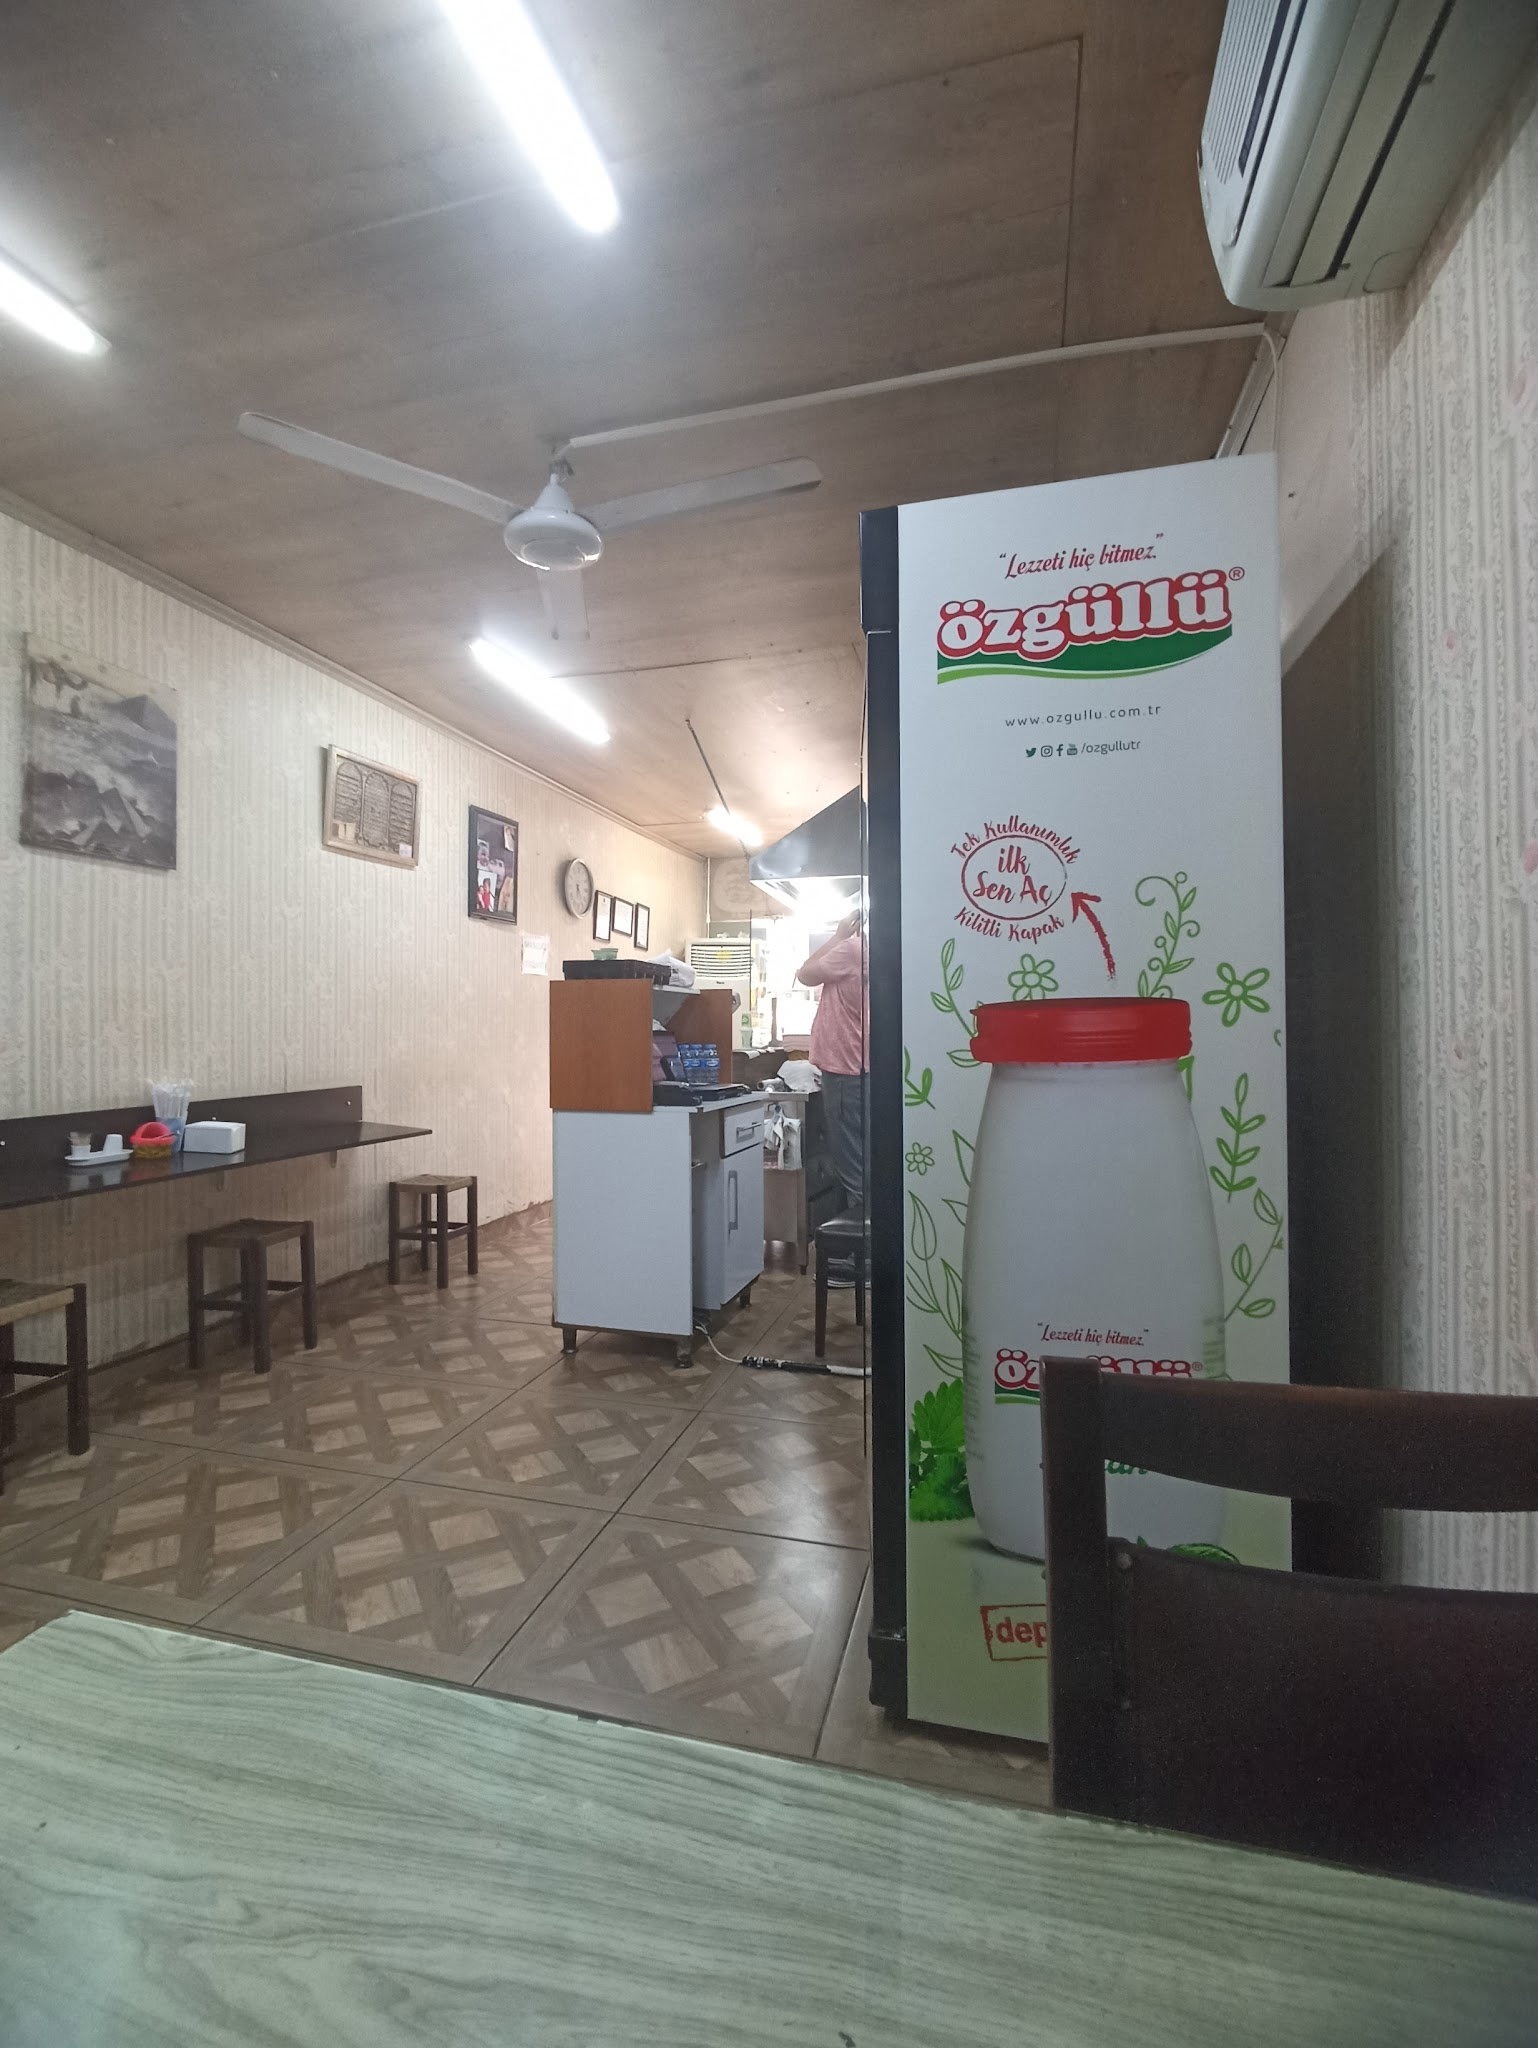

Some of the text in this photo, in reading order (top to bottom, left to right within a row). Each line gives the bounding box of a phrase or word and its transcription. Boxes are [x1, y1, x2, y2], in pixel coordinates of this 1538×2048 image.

[1068, 547, 1095, 571] hiç
[1005, 705, 1161, 727] www.ozgullu.com.tr
[951, 832, 980, 859] Tek
[998, 845, 1031, 875] ilk
[972, 870, 1053, 907] Sen Aç
[954, 906, 1065, 945] Kilitli Kapak
[1085, 1329, 1103, 1346] hiç
